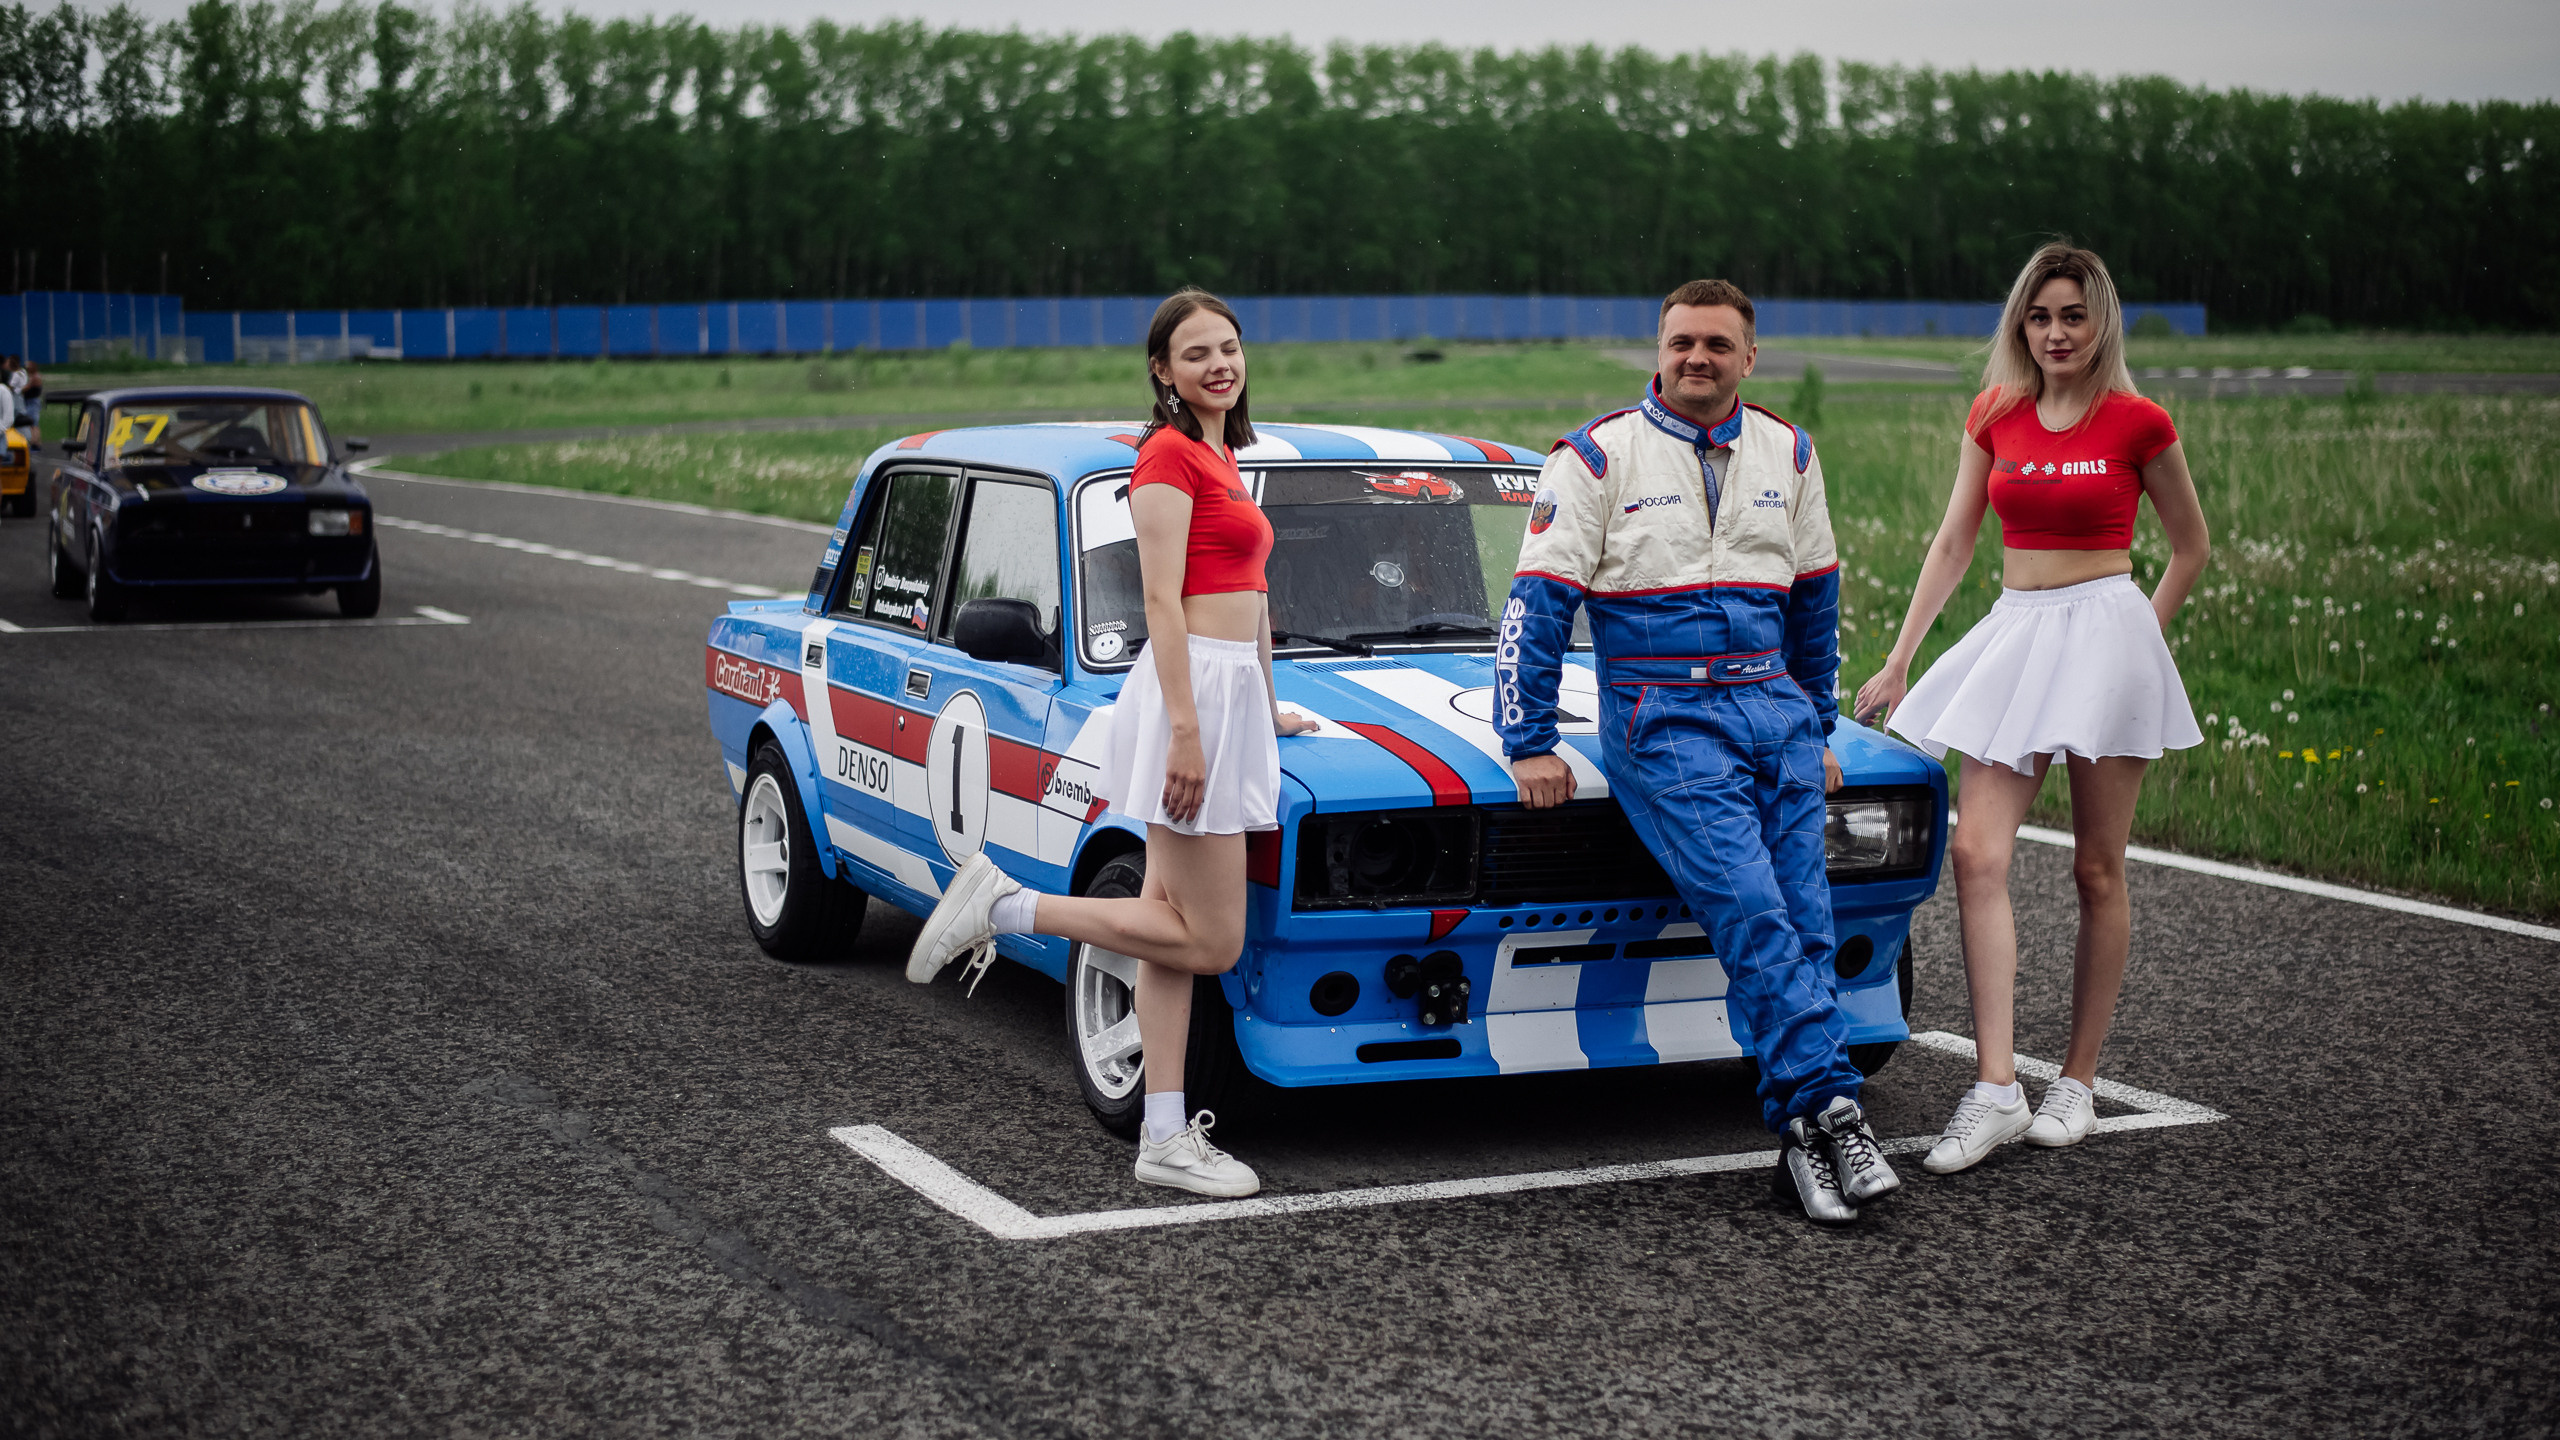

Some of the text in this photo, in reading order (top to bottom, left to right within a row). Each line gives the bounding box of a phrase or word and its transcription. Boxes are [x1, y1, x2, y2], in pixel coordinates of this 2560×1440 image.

[106, 414, 169, 447] 47
[2061, 459, 2107, 476] GIRLS
[1501, 492, 1535, 503] КЛА
[1639, 495, 1682, 510] РОССИЯ
[715, 653, 765, 701] Cordiant
[1498, 597, 1526, 727] sparco
[838, 745, 888, 793] DENSO
[951, 724, 964, 835] 1
